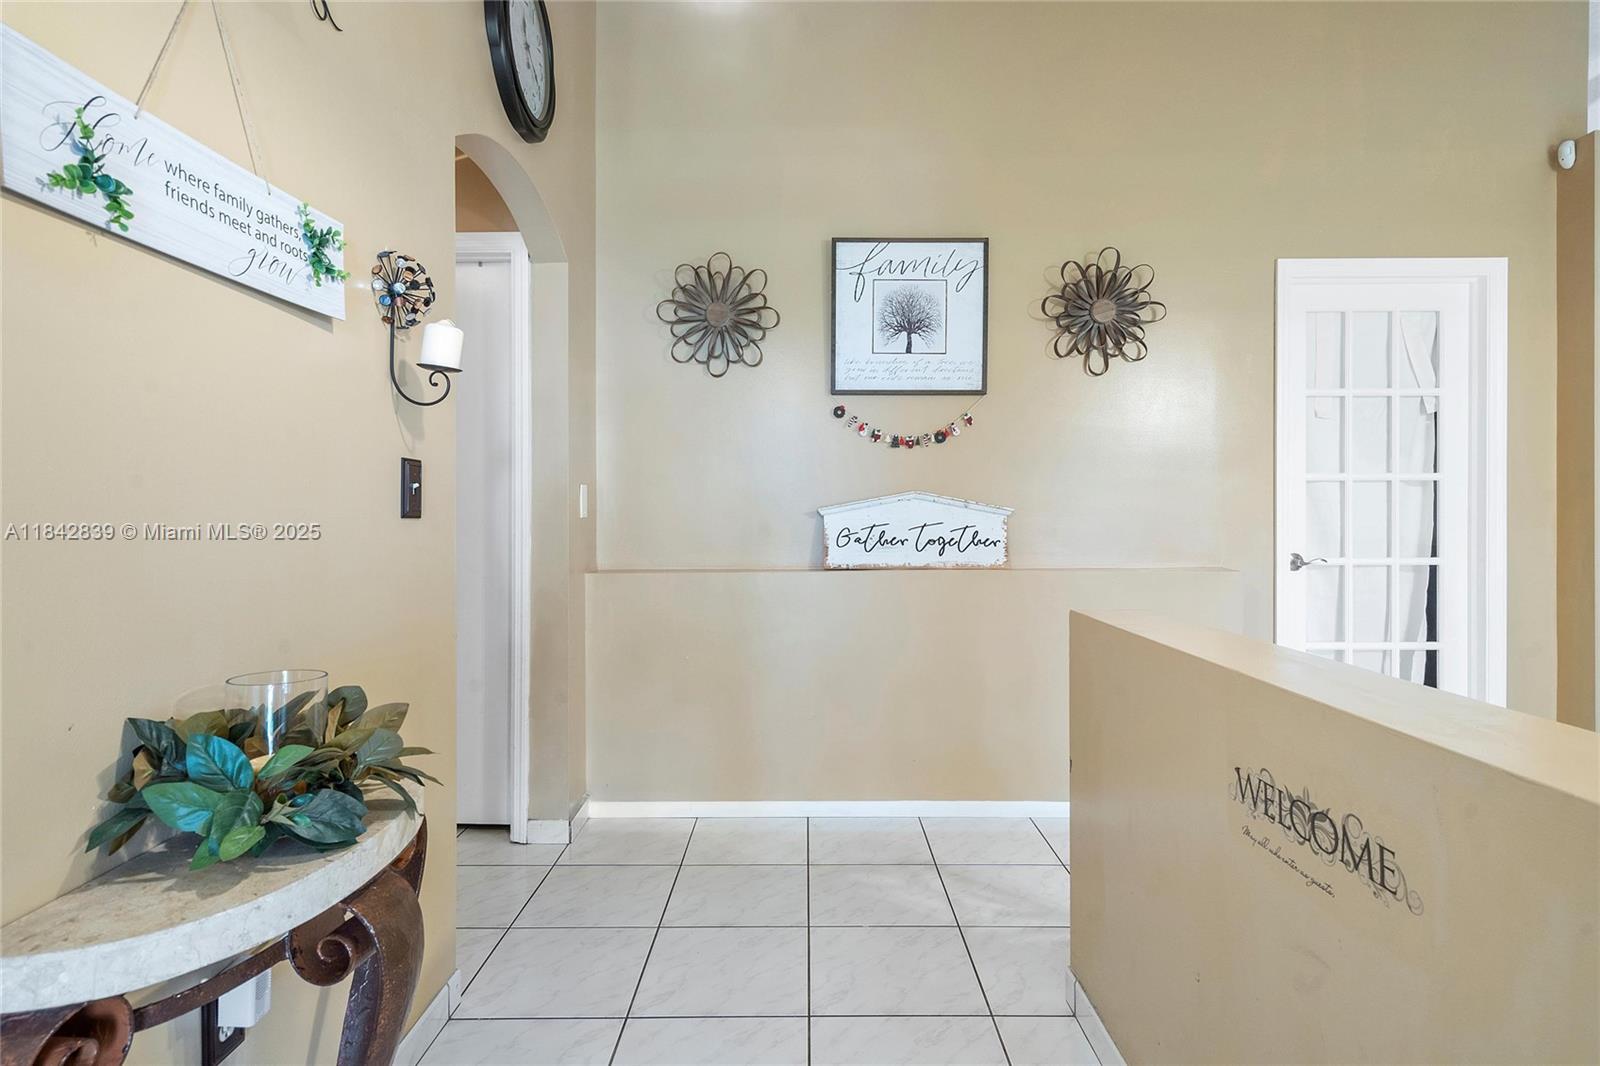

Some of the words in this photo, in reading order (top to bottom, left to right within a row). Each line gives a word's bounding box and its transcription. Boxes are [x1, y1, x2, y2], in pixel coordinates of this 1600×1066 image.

[164, 160, 210, 194] where
[214, 183, 253, 218] family
[165, 180, 215, 218] friends
[219, 211, 252, 237] meet
[255, 229, 277, 247] and
[280, 240, 309, 262] roots
[228, 248, 302, 285] grow
[836, 242, 984, 302] family
[836, 523, 909, 552] Gather
[1234, 767, 1399, 897] WELCOME
[1242, 825, 1257, 847] May
